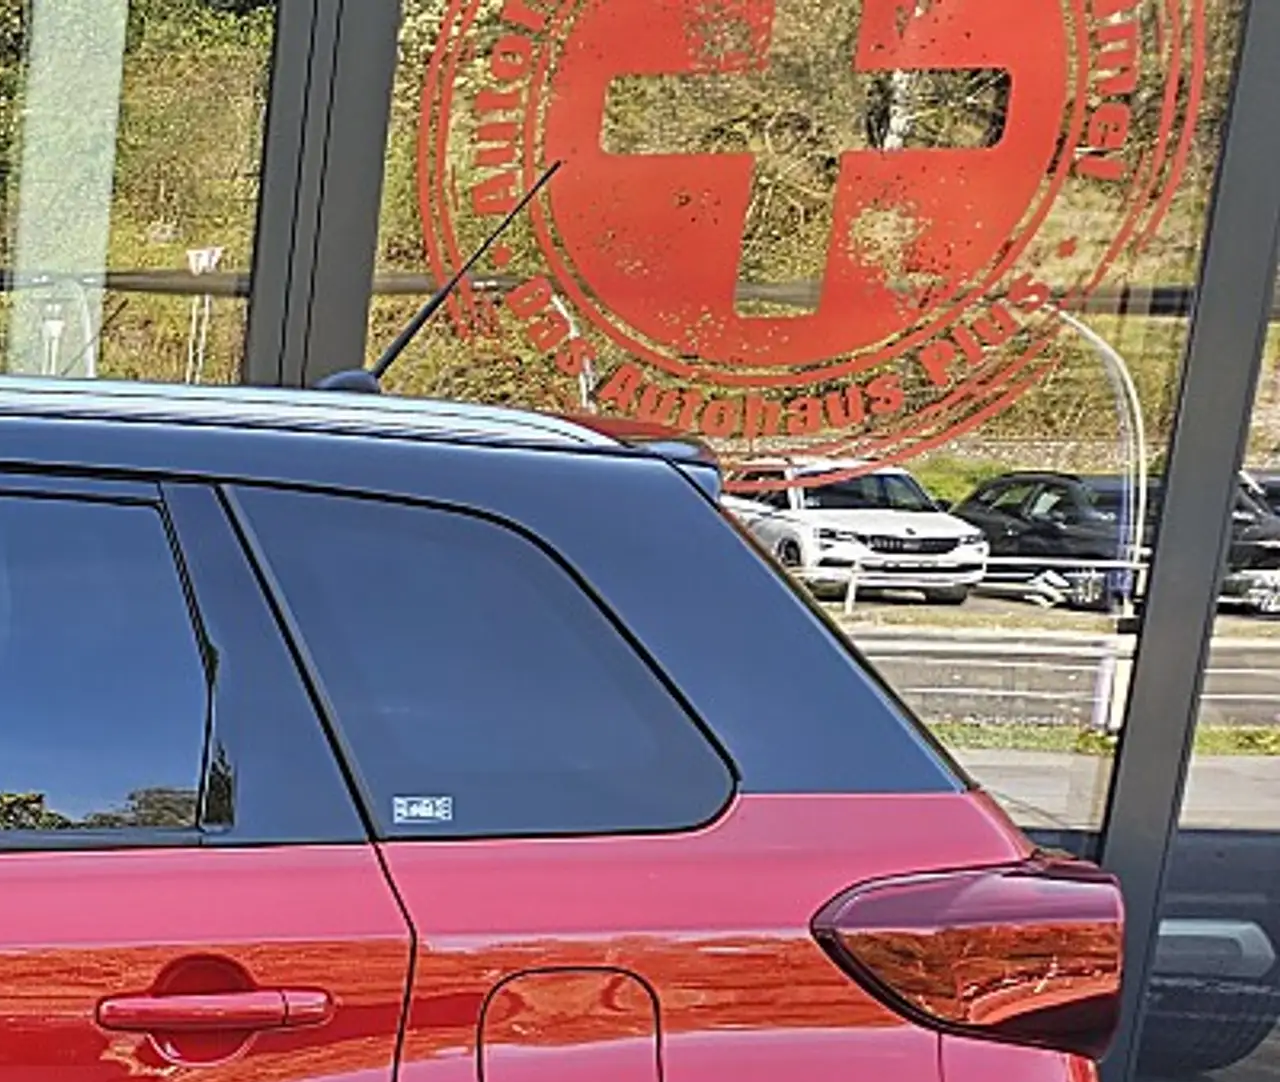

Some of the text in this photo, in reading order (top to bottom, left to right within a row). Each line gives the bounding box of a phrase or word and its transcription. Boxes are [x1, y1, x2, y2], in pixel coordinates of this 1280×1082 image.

[505, 273, 1051, 439] Das Autohaus Plus
